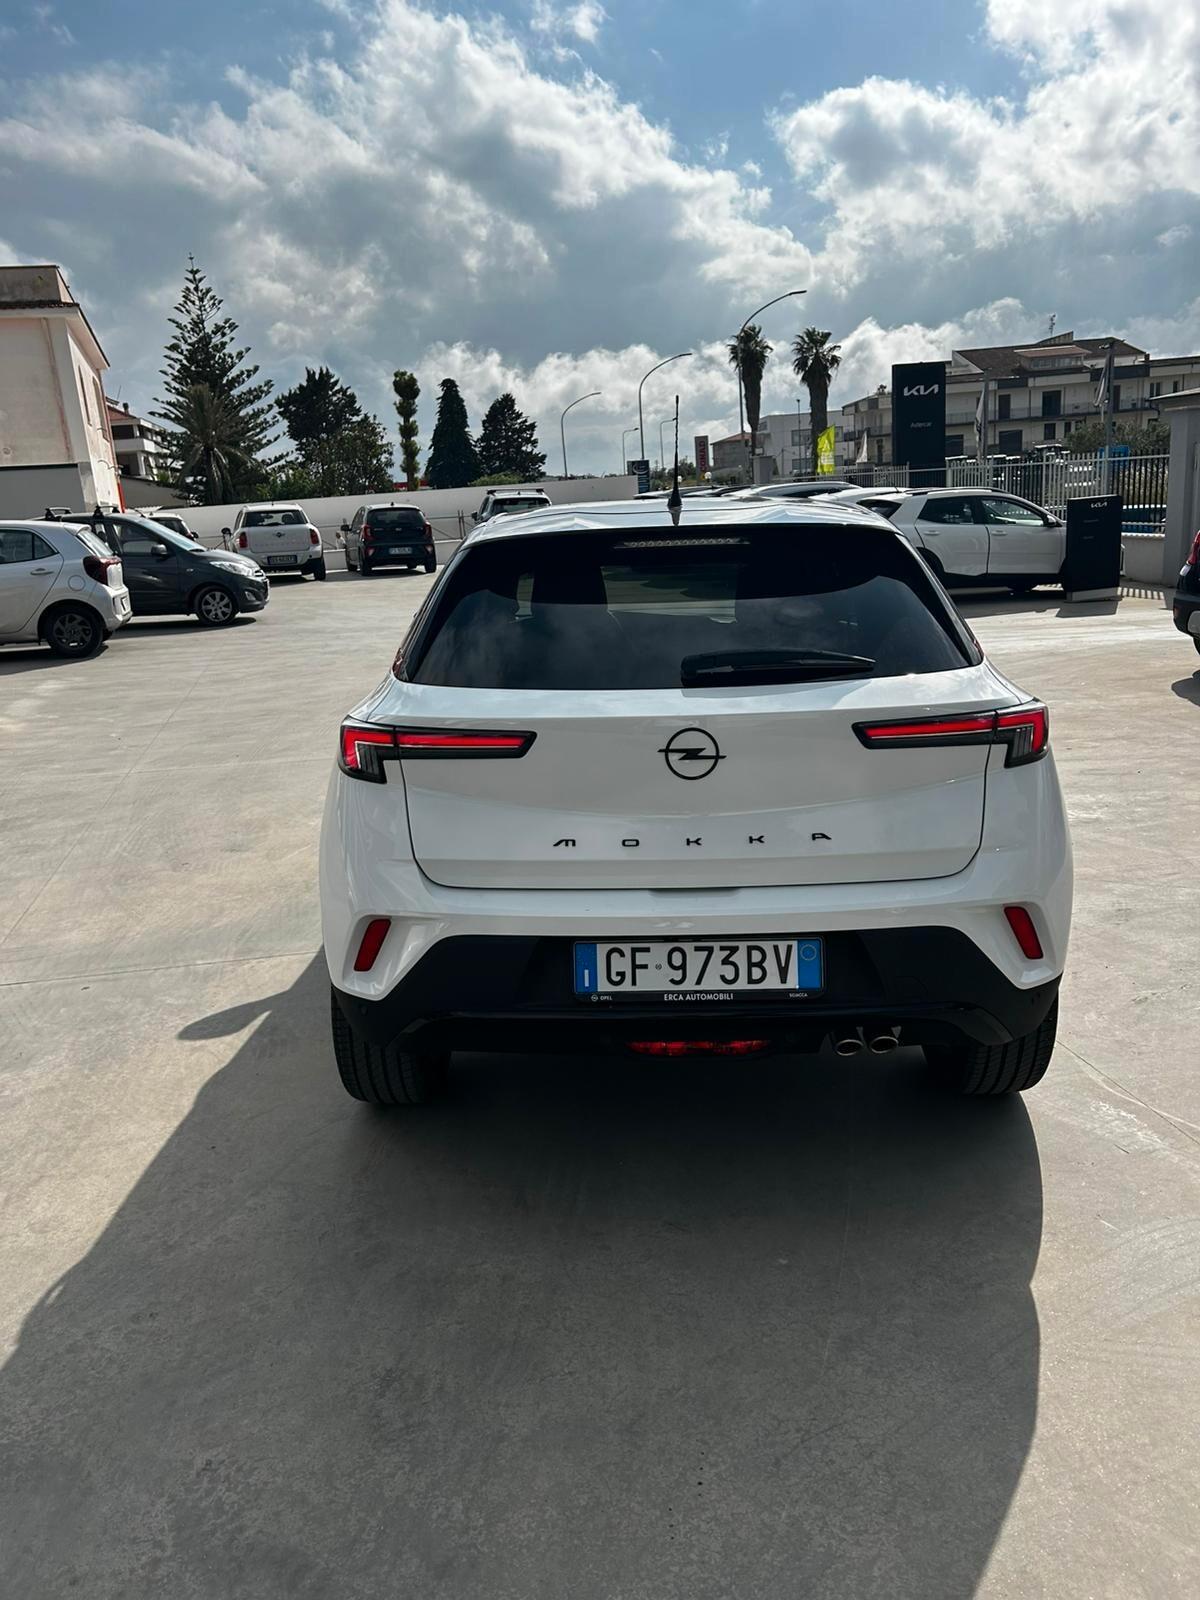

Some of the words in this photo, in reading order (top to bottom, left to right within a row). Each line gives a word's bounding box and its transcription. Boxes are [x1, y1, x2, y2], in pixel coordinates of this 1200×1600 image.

[904, 384, 939, 396] KIA
[553, 833, 832, 847] MOKKA
[664, 993, 684, 1001] ERCA
[685, 992, 734, 1001] AUTOMOBILI
